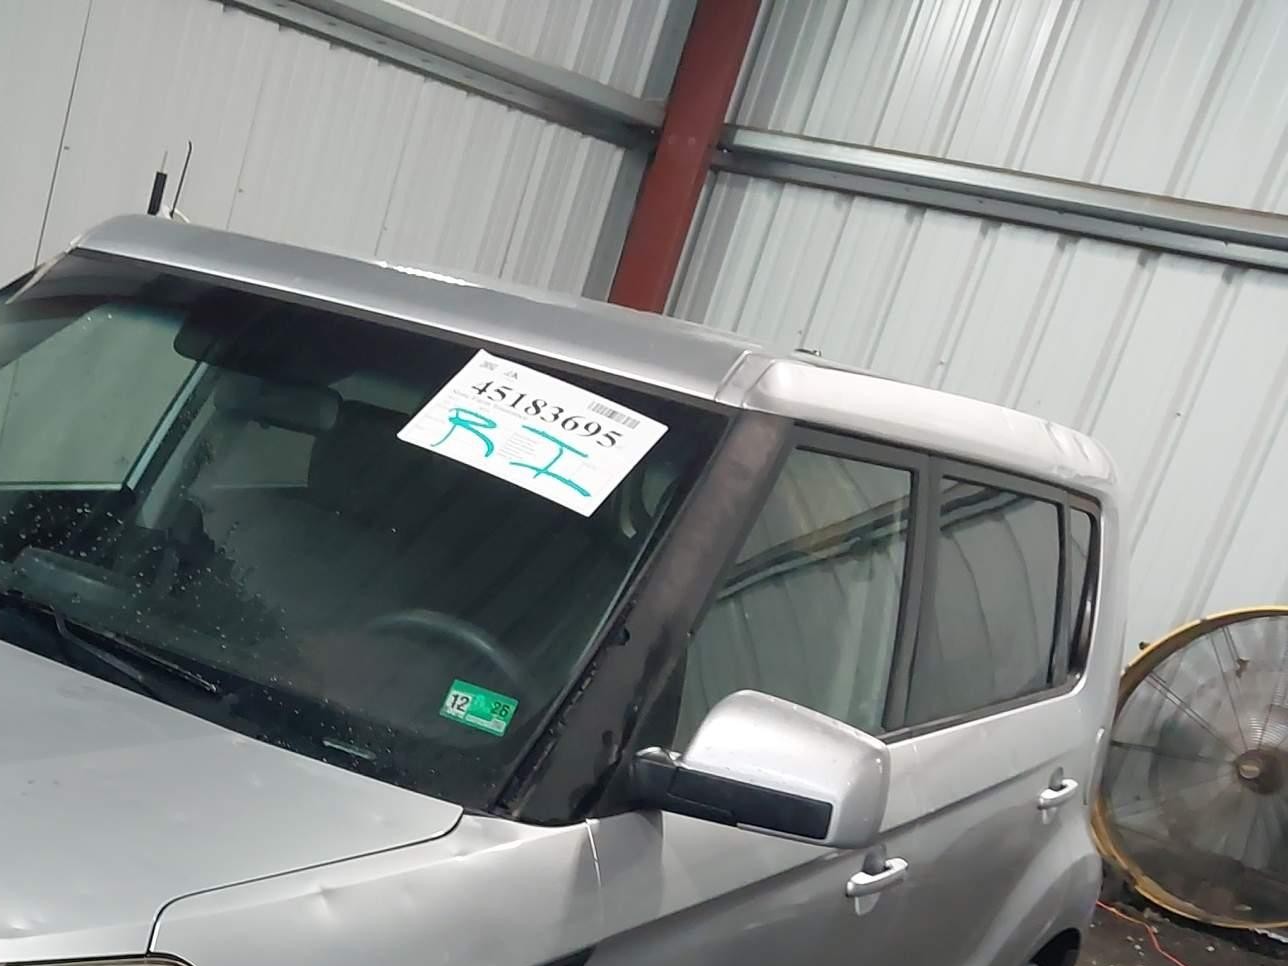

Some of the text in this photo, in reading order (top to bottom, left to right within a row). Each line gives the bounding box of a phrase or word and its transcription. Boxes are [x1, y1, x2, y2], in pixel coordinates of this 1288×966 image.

[430, 407, 498, 458] R
[471, 380, 623, 449] 45183695
[451, 694, 470, 713] 12
